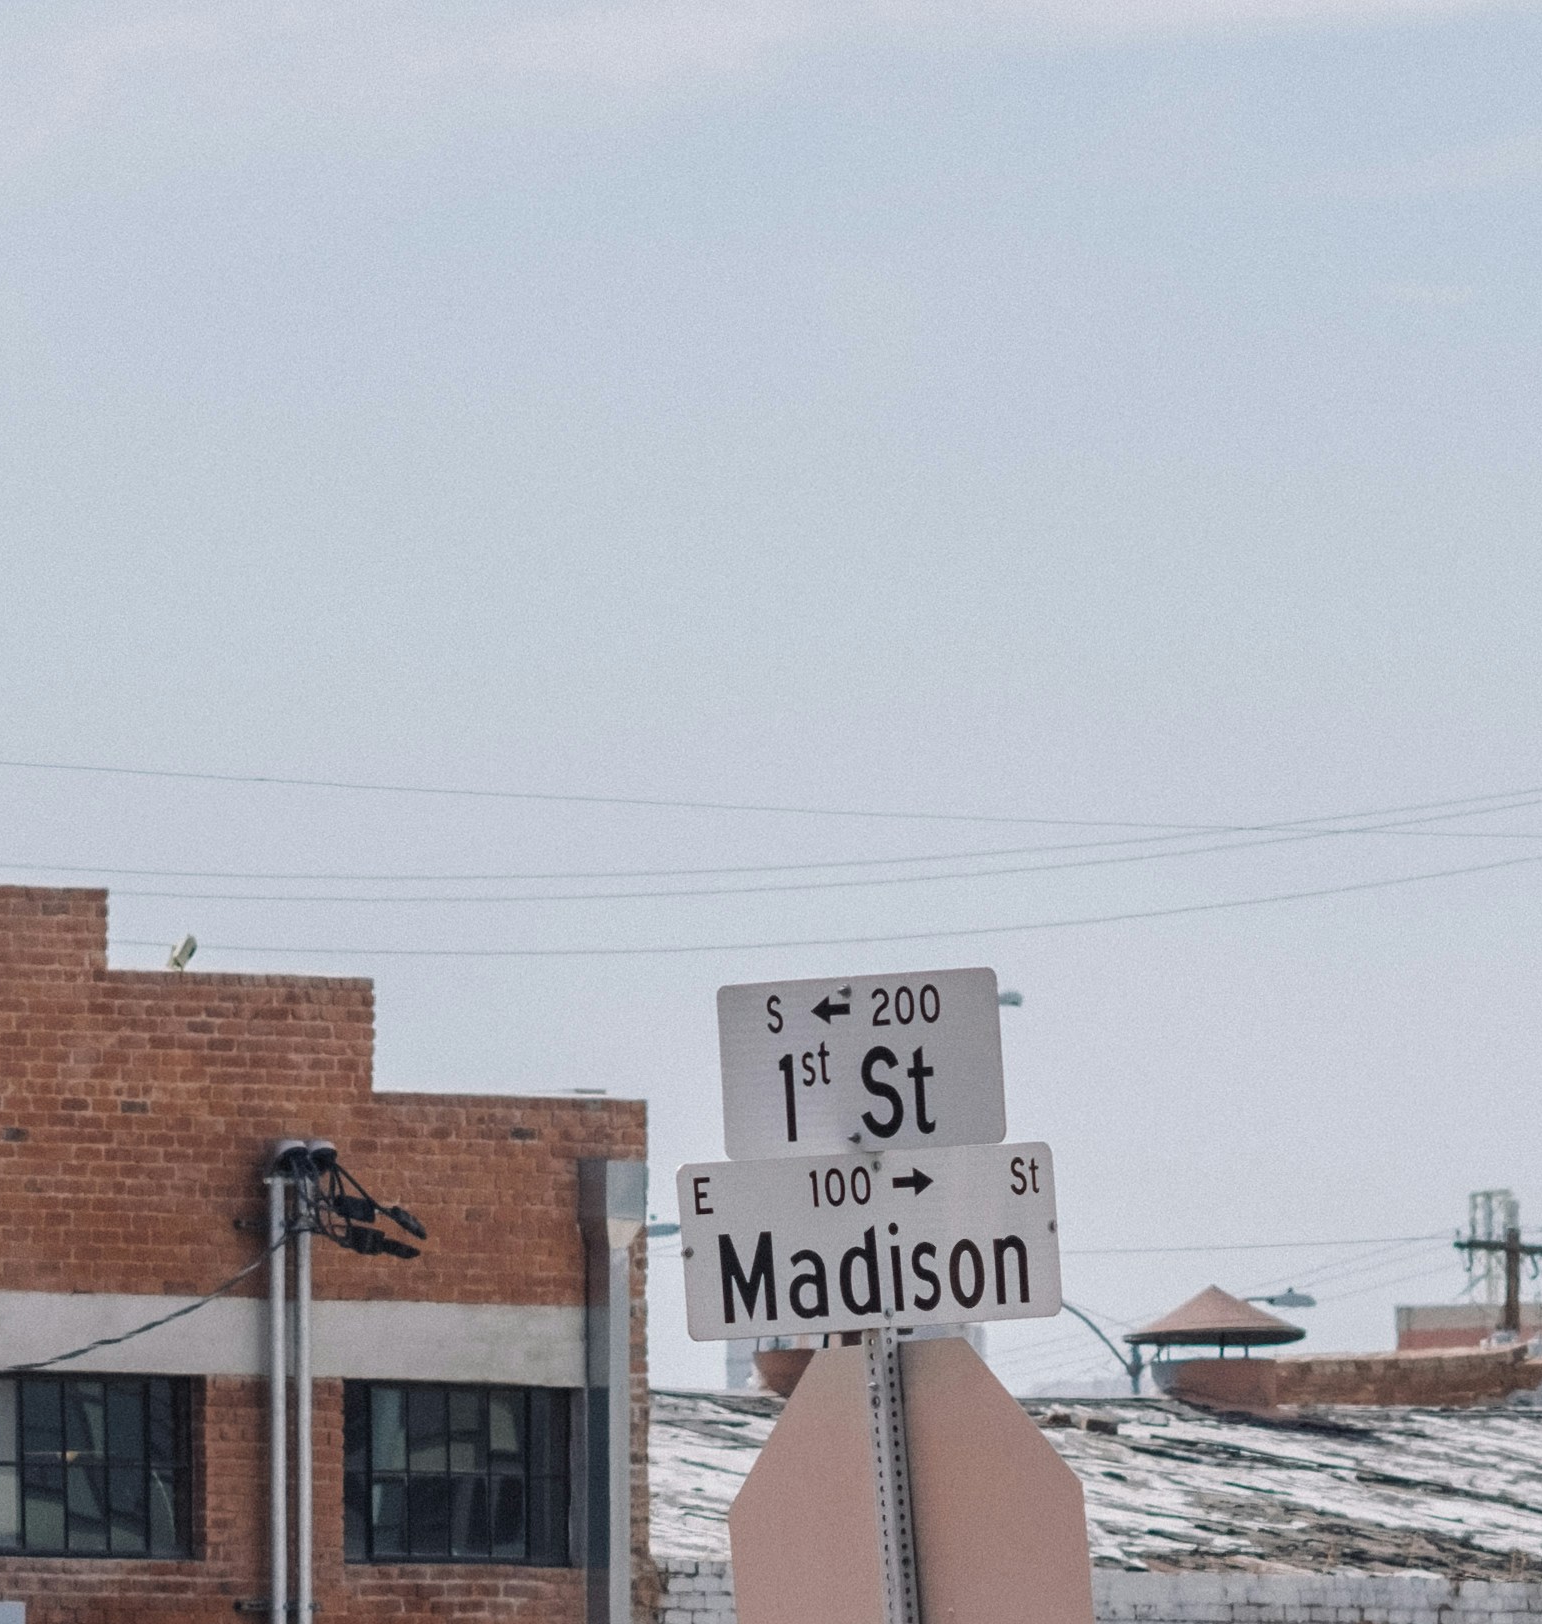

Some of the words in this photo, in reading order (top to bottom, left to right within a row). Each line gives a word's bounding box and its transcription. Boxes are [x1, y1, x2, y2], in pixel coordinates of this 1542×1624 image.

[766, 994, 784, 1034] S
[871, 984, 941, 1026] 200
[779, 1041, 831, 1142] 1st
[861, 1045, 936, 1138] St
[693, 1176, 714, 1215] E
[809, 1166, 871, 1207] 100
[1010, 1156, 1040, 1195] St
[718, 1222, 1030, 1324] Madison
